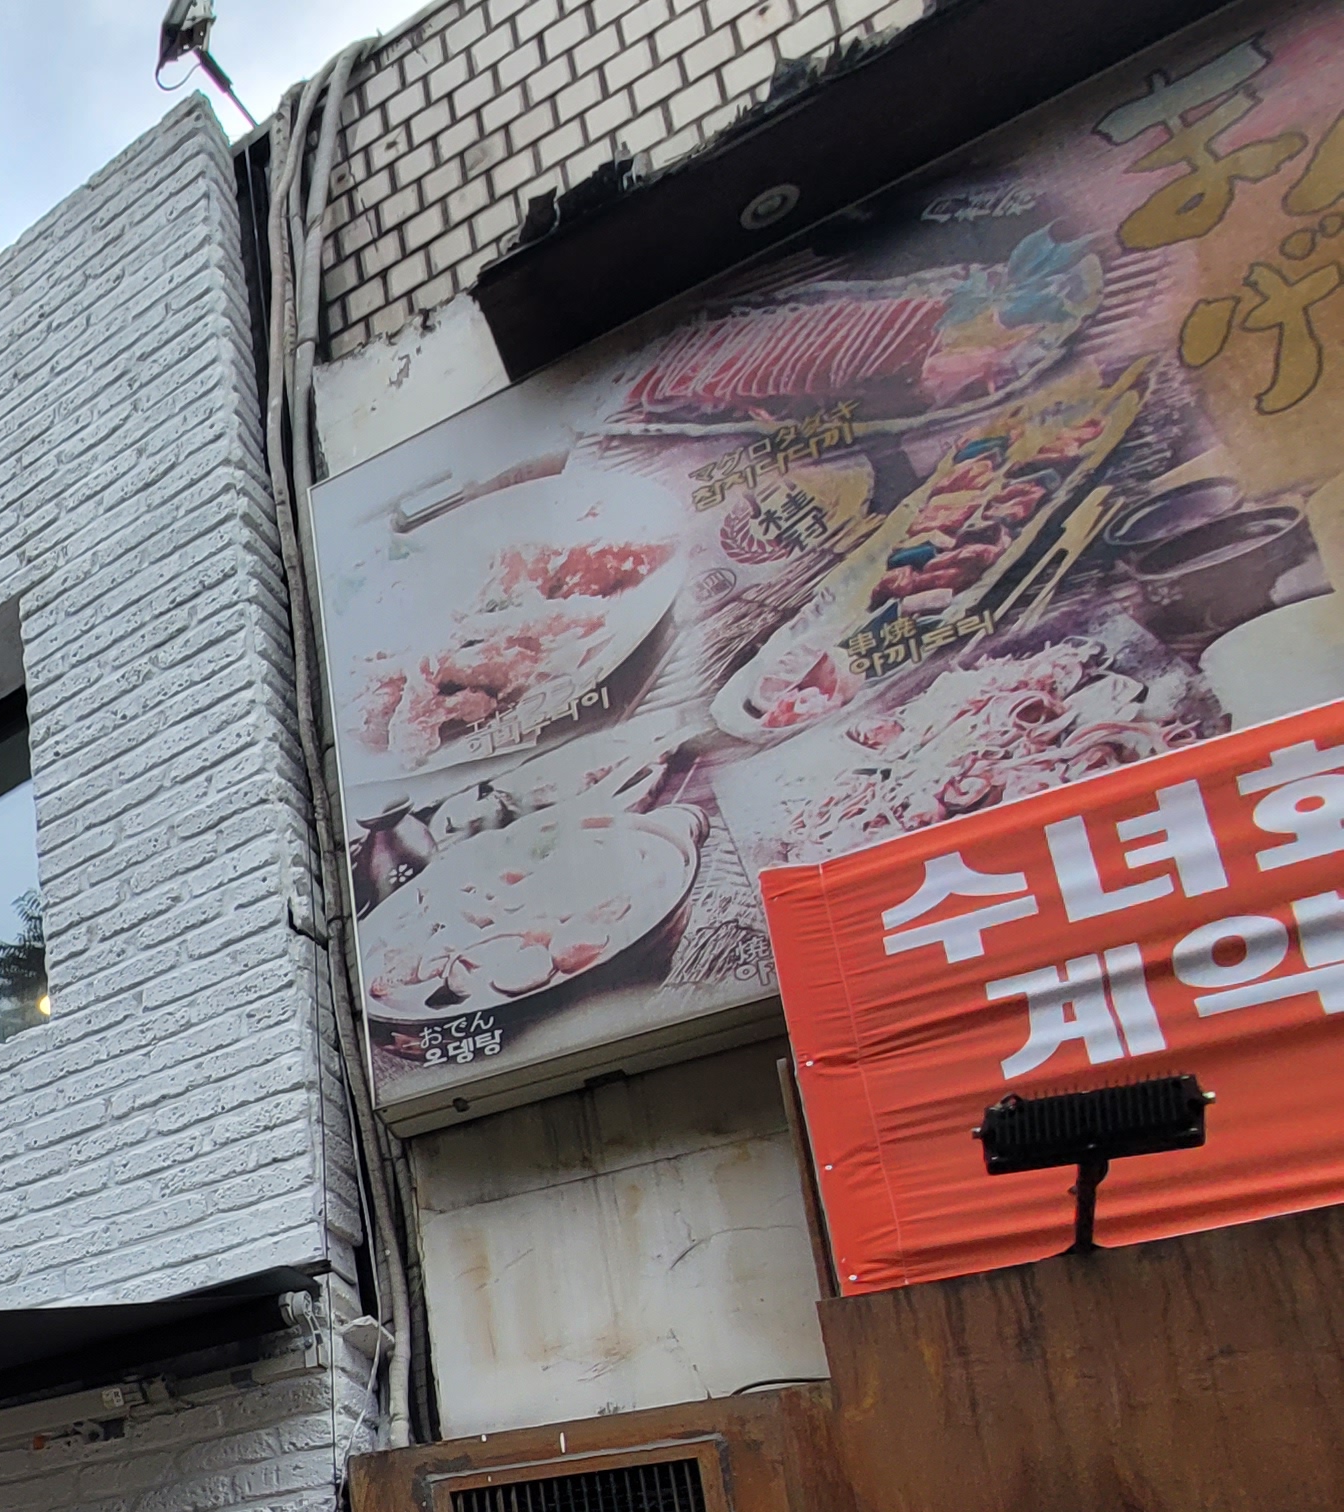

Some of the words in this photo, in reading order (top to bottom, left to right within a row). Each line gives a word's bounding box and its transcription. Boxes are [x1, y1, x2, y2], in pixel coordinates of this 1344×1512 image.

[419, 1012, 495, 1047] おでん
[422, 1029, 504, 1068] 오뎅탕
